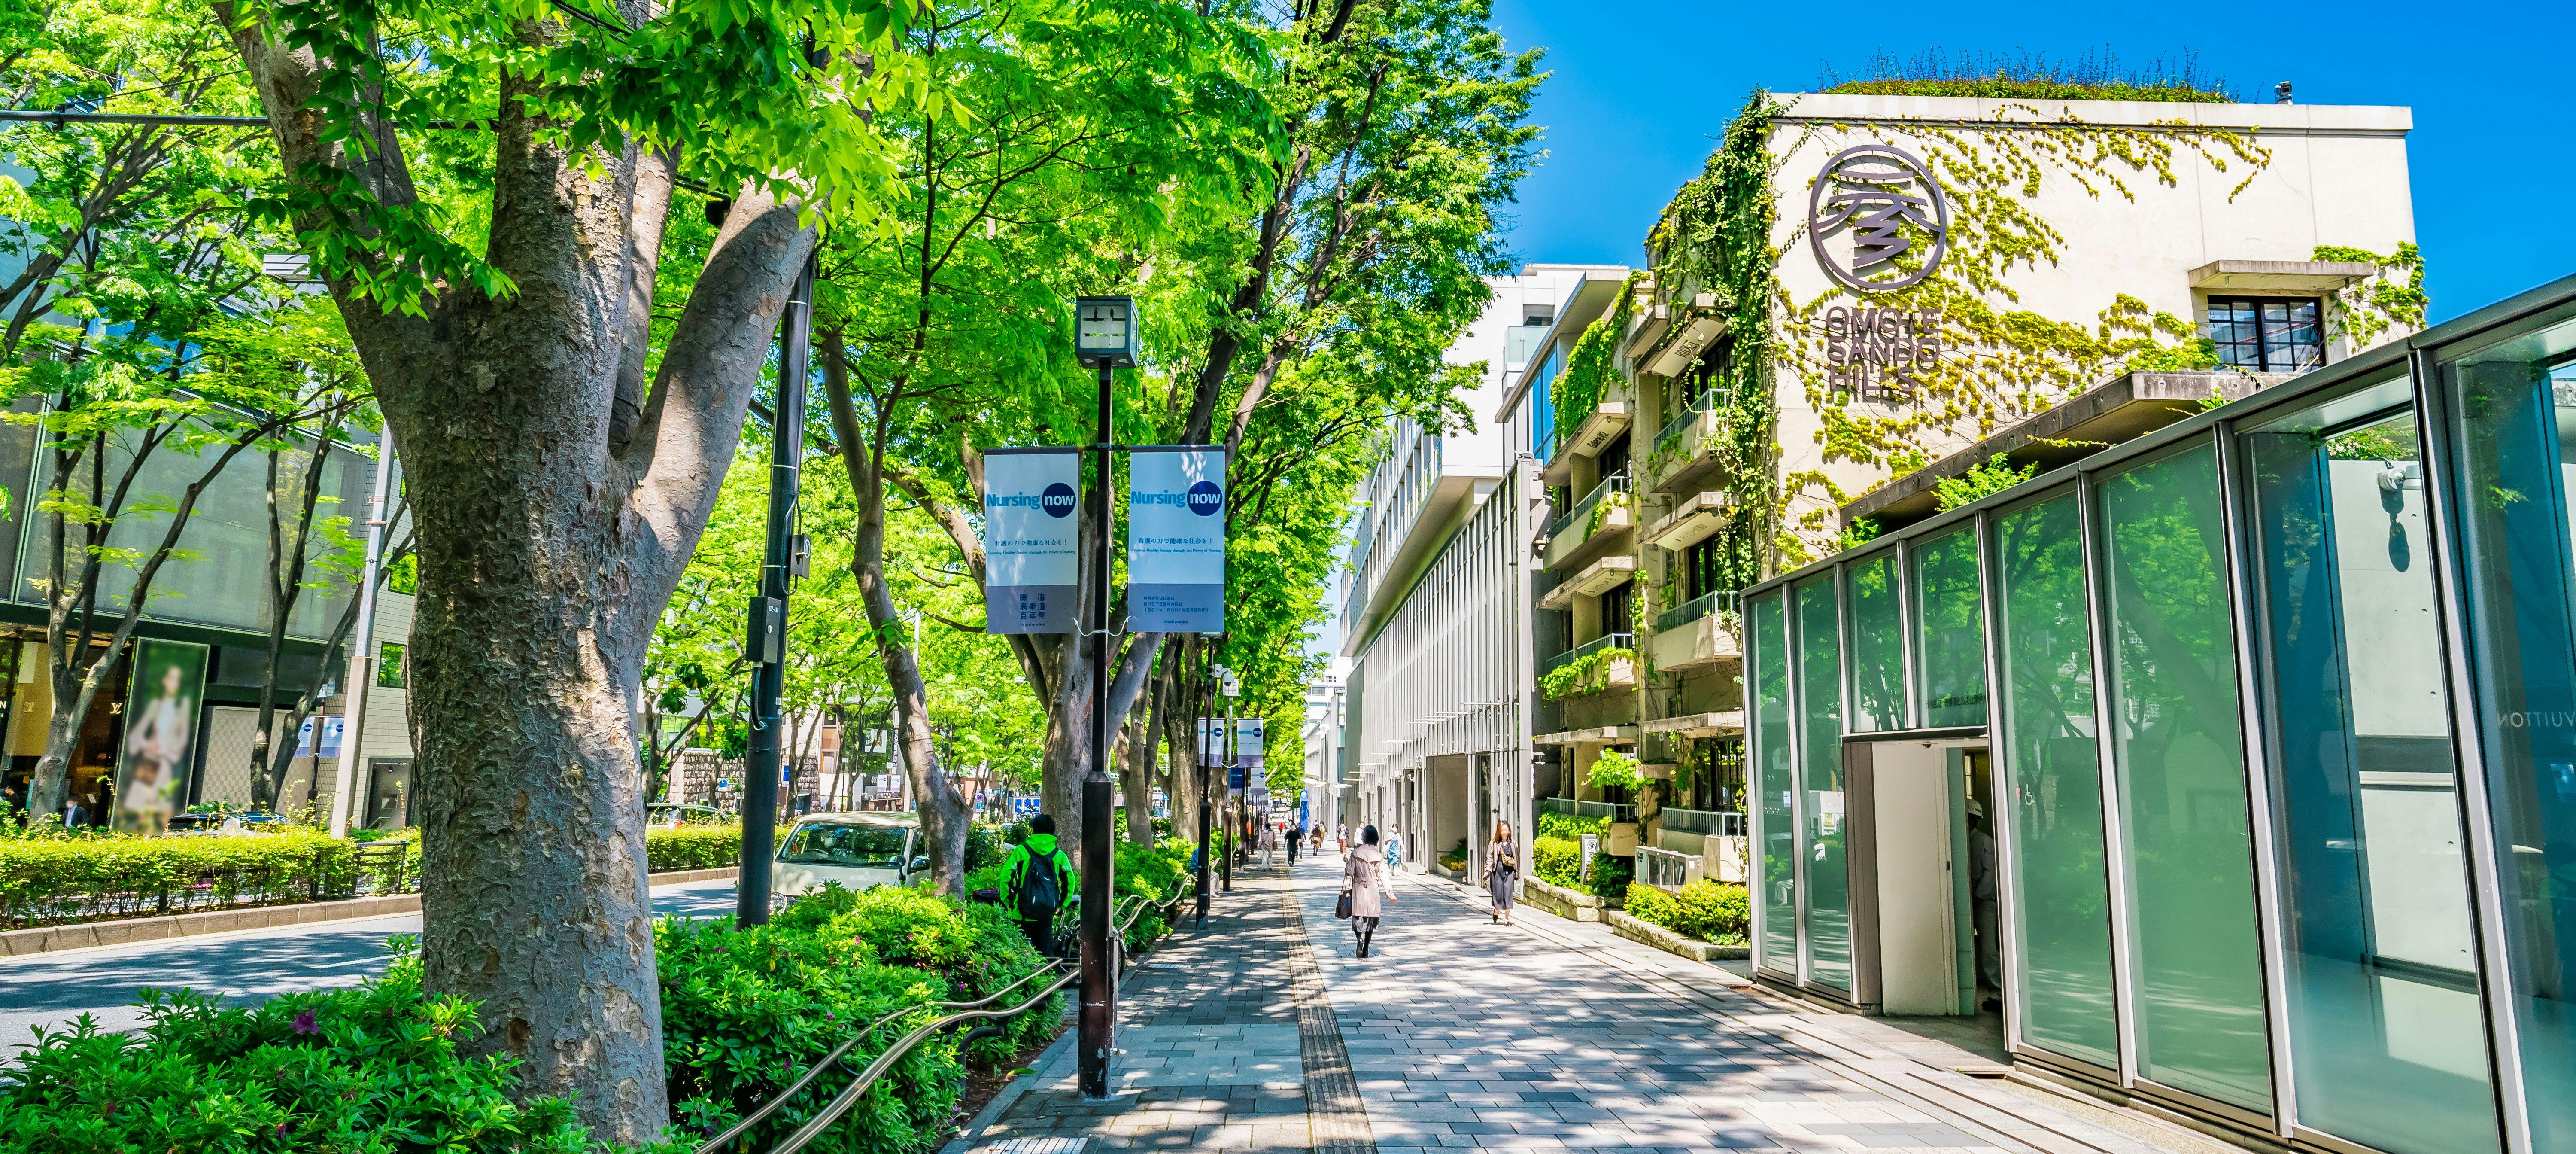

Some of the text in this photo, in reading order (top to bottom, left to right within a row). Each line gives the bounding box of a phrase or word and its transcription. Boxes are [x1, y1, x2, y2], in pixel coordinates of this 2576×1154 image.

[1828, 336, 1940, 362] SANDO
[986, 492, 1074, 510] Nursing now
[1131, 489, 1221, 508] Nursing now
